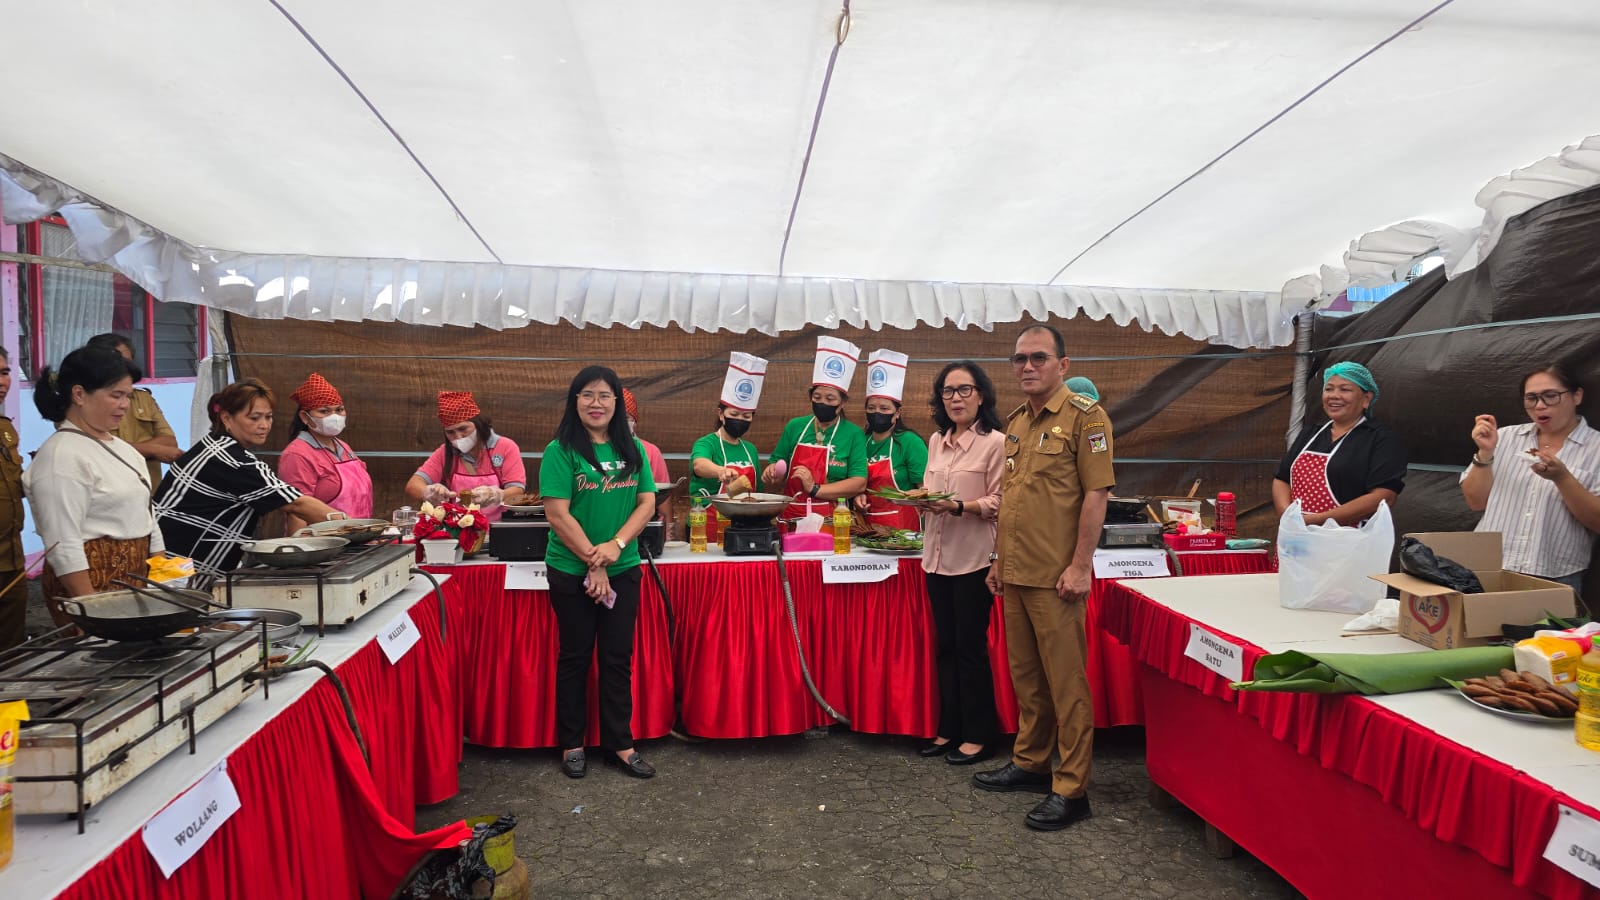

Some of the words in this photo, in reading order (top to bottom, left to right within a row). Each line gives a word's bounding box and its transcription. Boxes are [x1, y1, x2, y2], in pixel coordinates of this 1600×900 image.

[831, 563, 891, 572] KARONDORAN
[1108, 560, 1155, 568] AMONGENA
[1199, 634, 1235, 660] AMONGENA
[1205, 652, 1223, 668] SATU
[174, 799, 219, 847] WOLAANG
